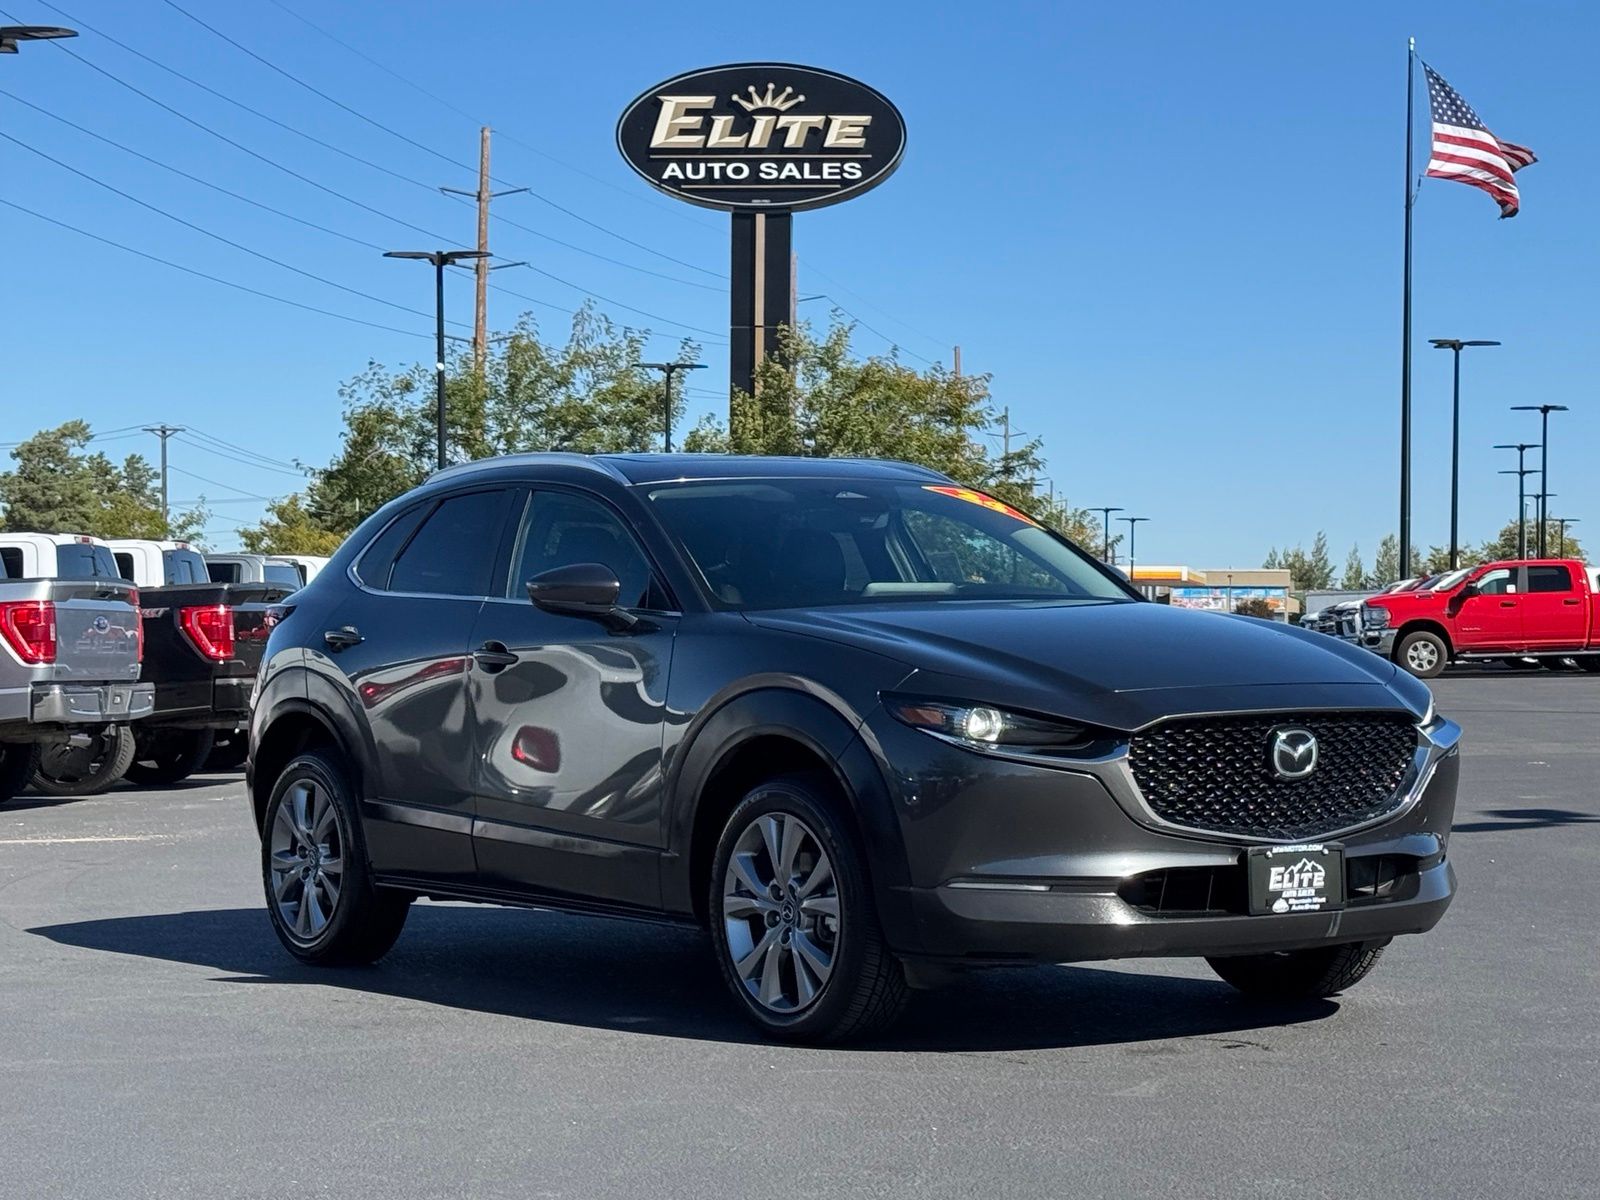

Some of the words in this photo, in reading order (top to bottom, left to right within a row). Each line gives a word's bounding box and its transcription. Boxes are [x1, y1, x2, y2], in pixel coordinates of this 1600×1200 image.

[650, 95, 872, 148] ELITE
[661, 162, 750, 180] AUTO
[758, 162, 863, 180] SALES
[1269, 867, 1325, 890] ELITE
